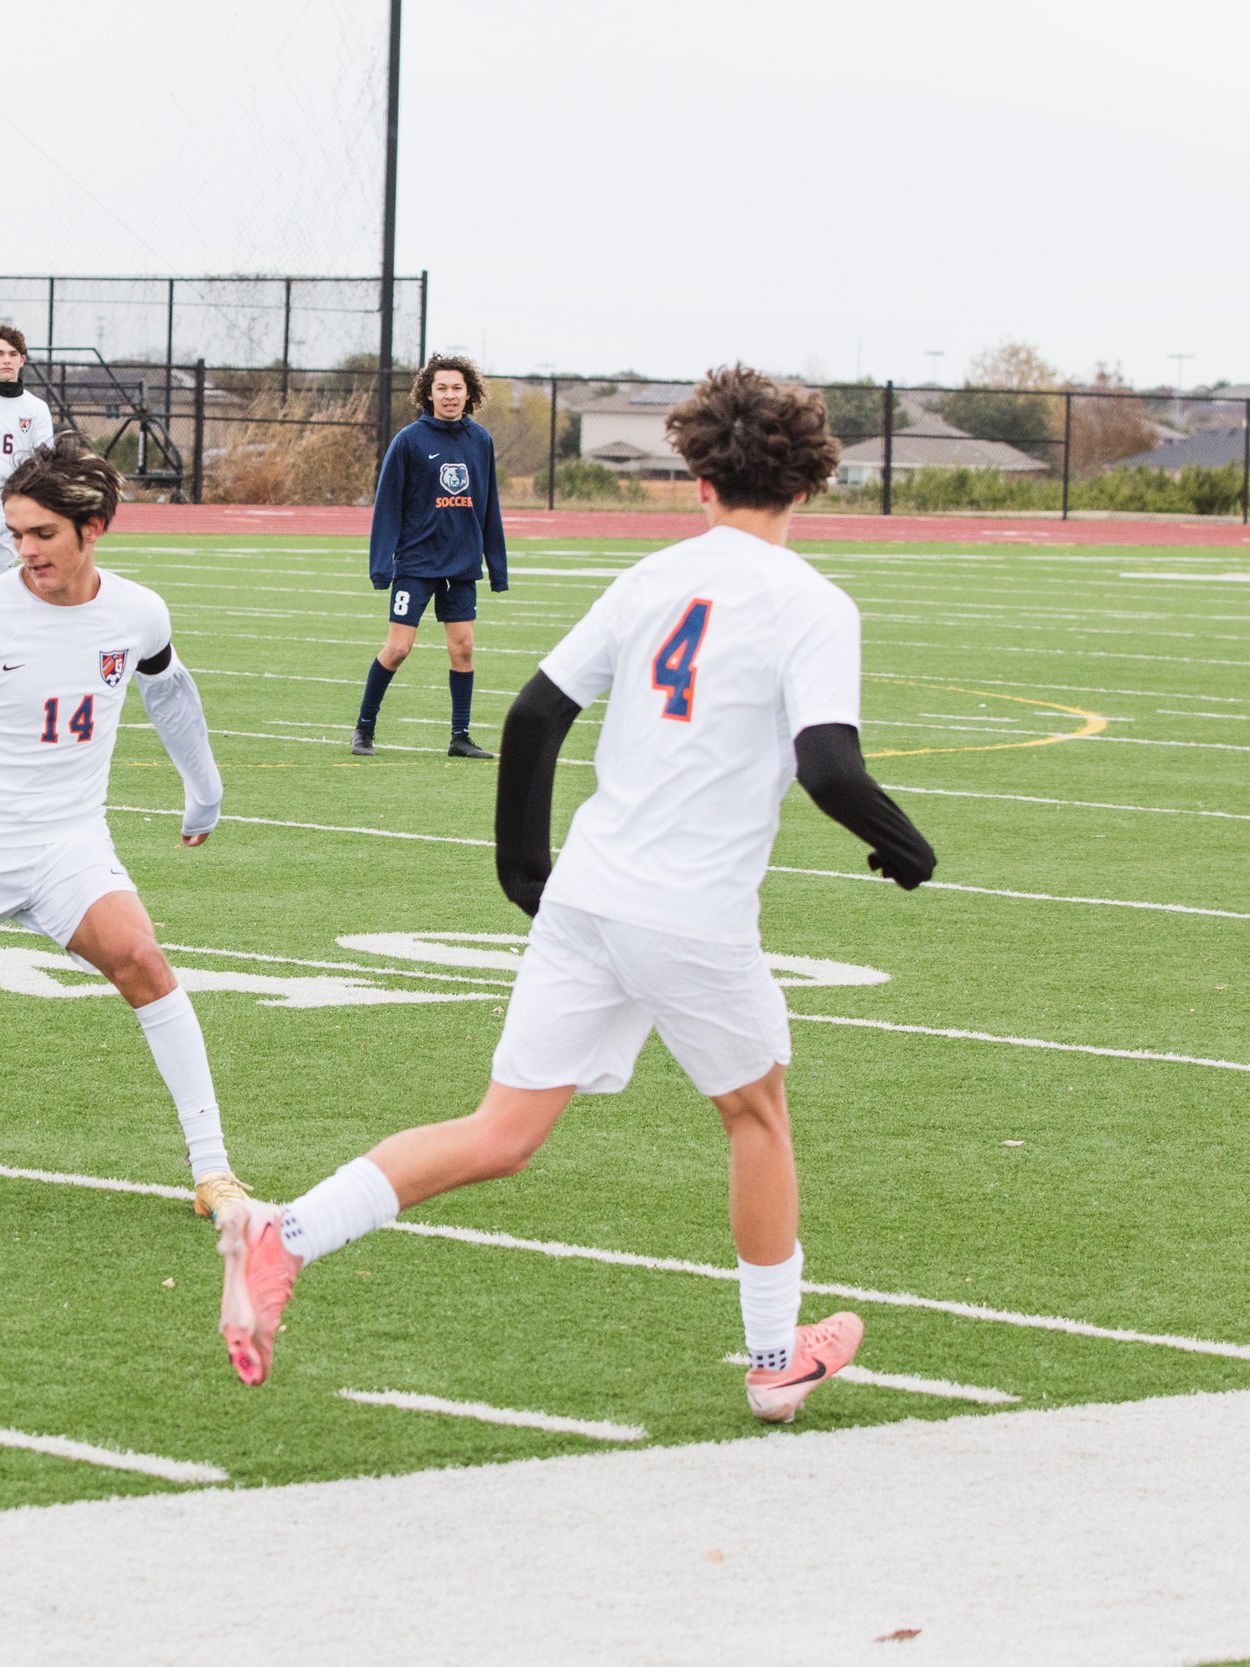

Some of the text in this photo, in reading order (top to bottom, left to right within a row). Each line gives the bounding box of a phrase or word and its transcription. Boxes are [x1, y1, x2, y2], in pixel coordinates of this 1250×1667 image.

[2, 433, 14, 454] 6
[435, 496, 474, 508] SOCCER
[393, 590, 411, 616] 8
[652, 598, 713, 722] 4
[40, 694, 95, 744] 14
